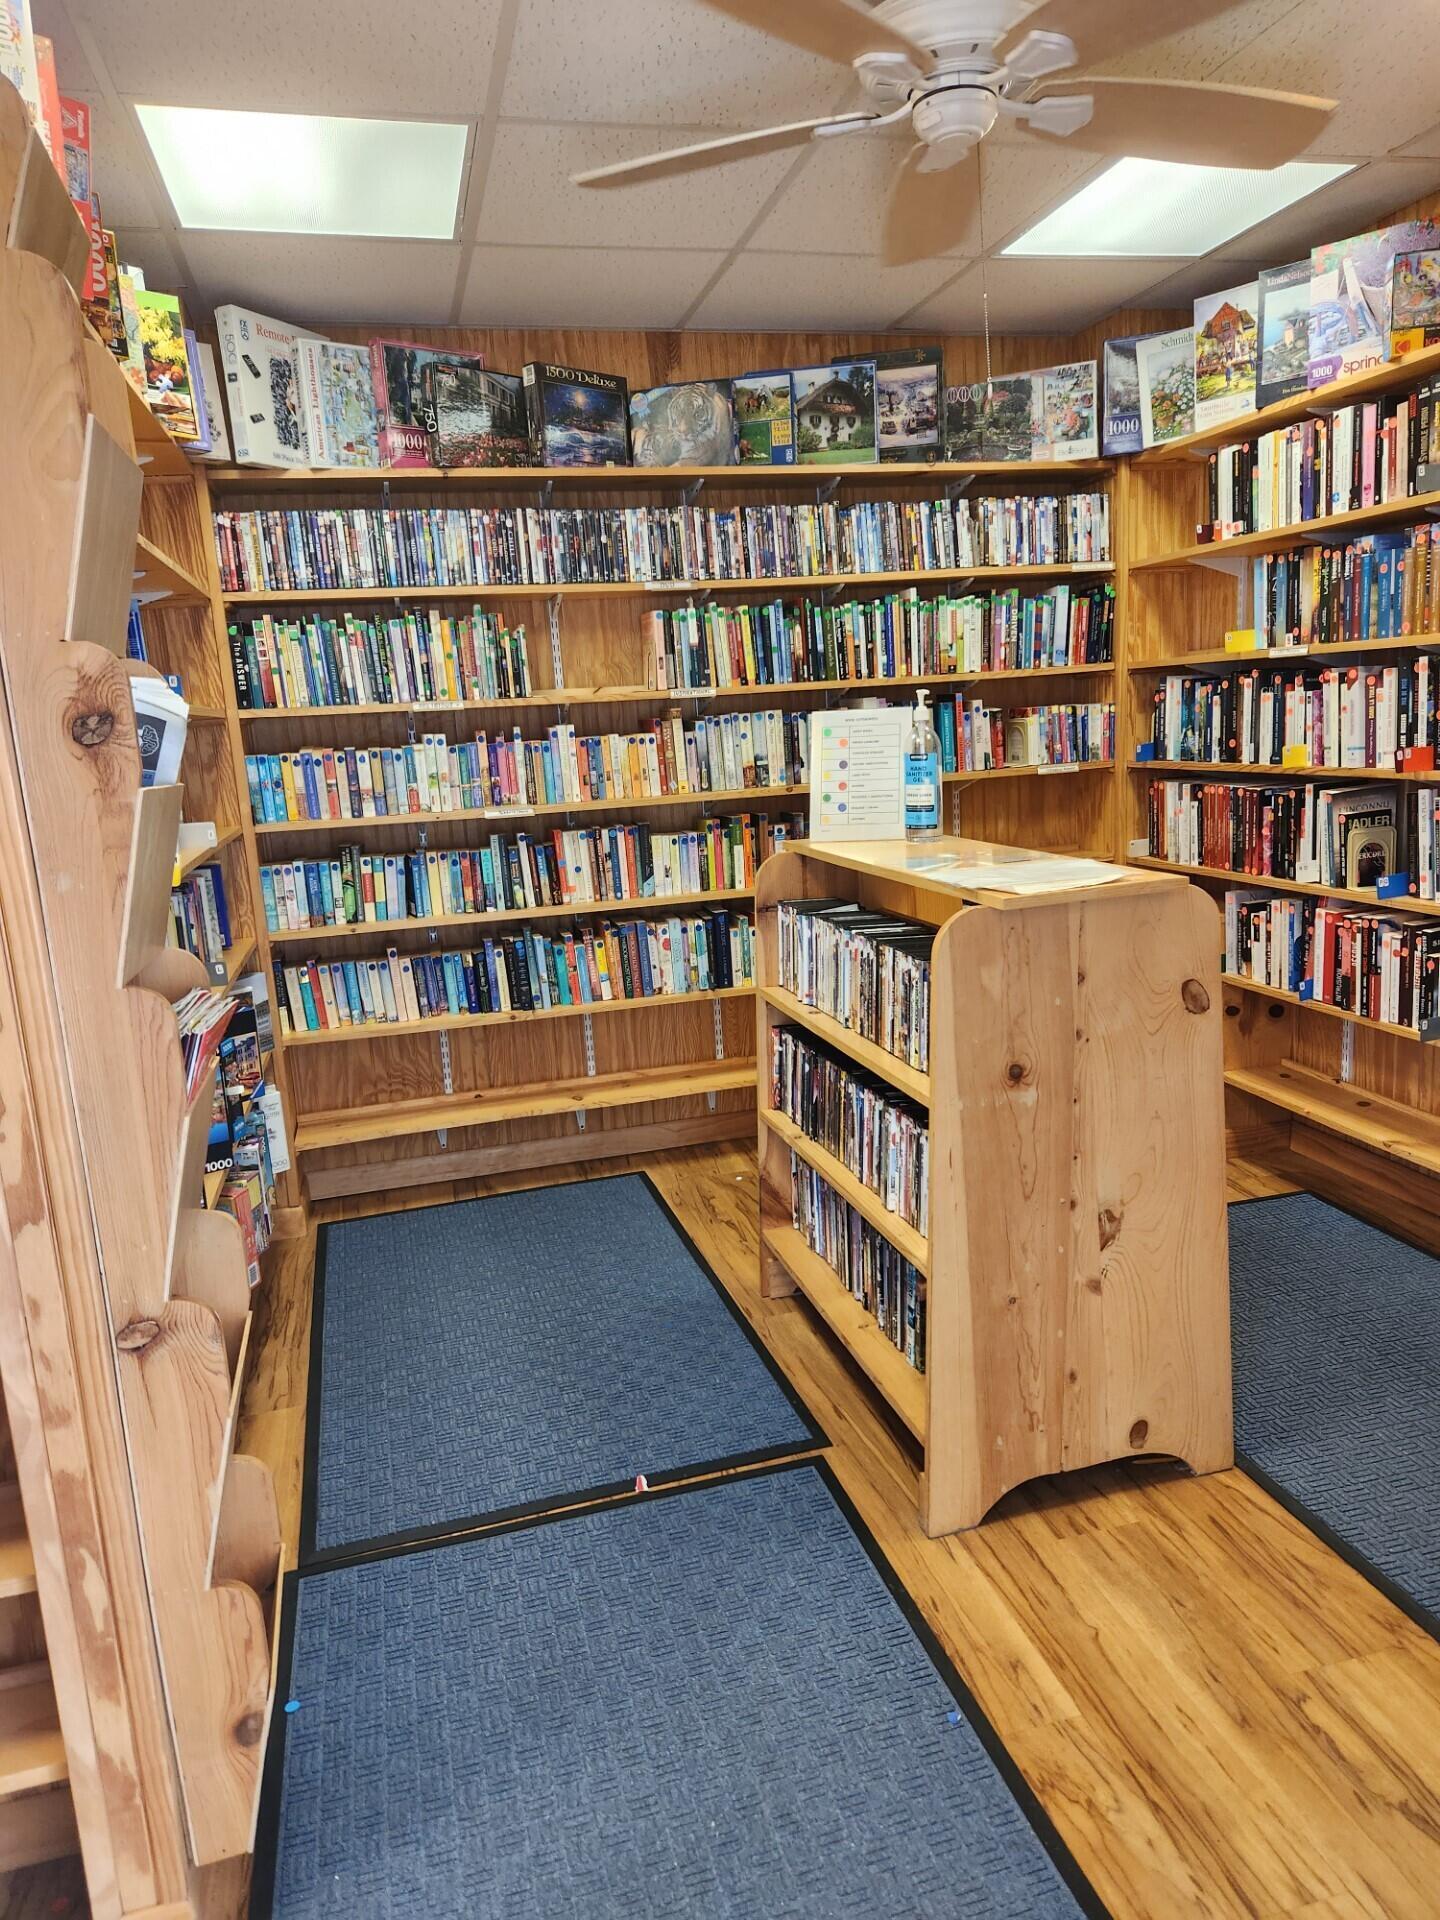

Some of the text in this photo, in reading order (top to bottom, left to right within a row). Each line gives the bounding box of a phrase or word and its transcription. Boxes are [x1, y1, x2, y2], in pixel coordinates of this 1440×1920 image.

[545, 365, 617, 389] 1500 Deluxe
[1312, 365, 1333, 379] 1000
[423, 404, 437, 434] 750
[1107, 418, 1140, 436] 1000
[391, 431, 423, 450] 1000
[1010, 608, 1018, 642] DRIVEN
[233, 642, 247, 691] The ANSWER
[205, 1158, 234, 1173] 1000
